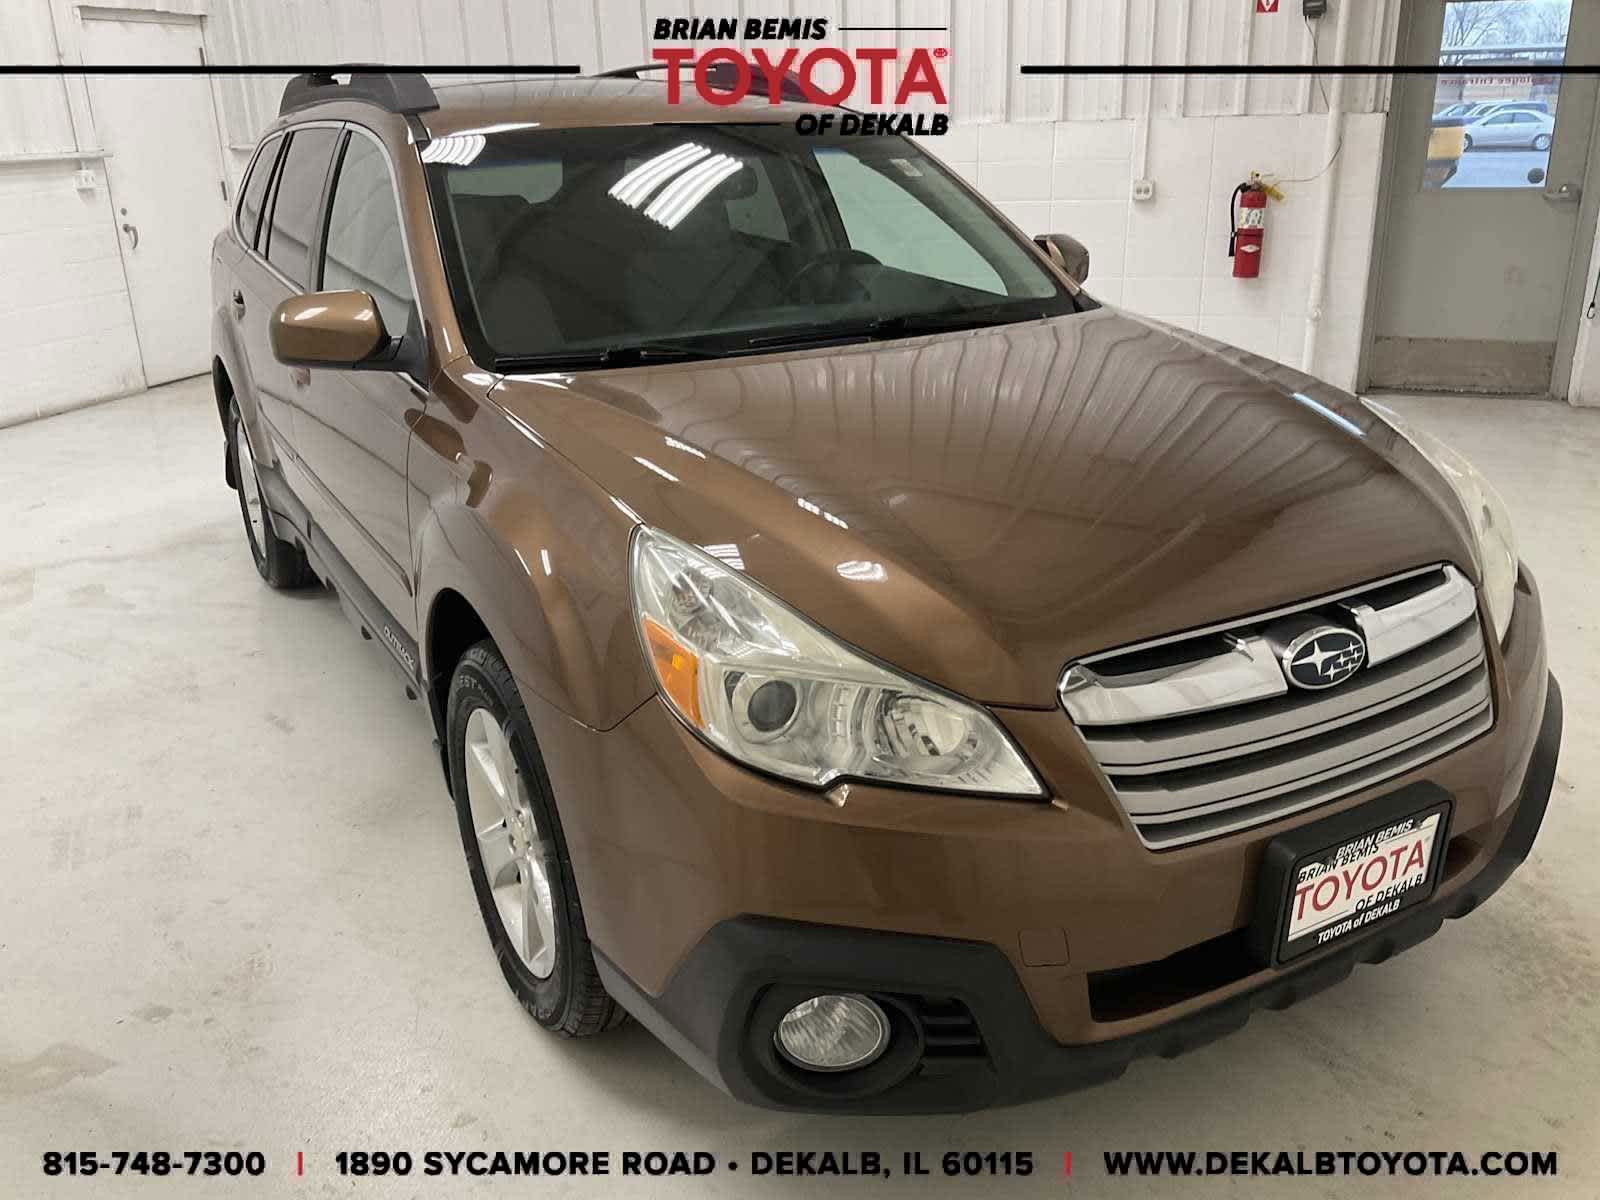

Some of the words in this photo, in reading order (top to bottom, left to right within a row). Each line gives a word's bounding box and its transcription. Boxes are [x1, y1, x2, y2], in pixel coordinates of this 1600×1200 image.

[1336, 834, 1376, 860] BRIAN
[1376, 819, 1414, 844] BEMIS
[1295, 839, 1425, 921] TOYOTA
[1317, 919, 1352, 944] TOYOTA
[1353, 911, 1363, 928] of
[1364, 898, 1401, 924] DEKALB
